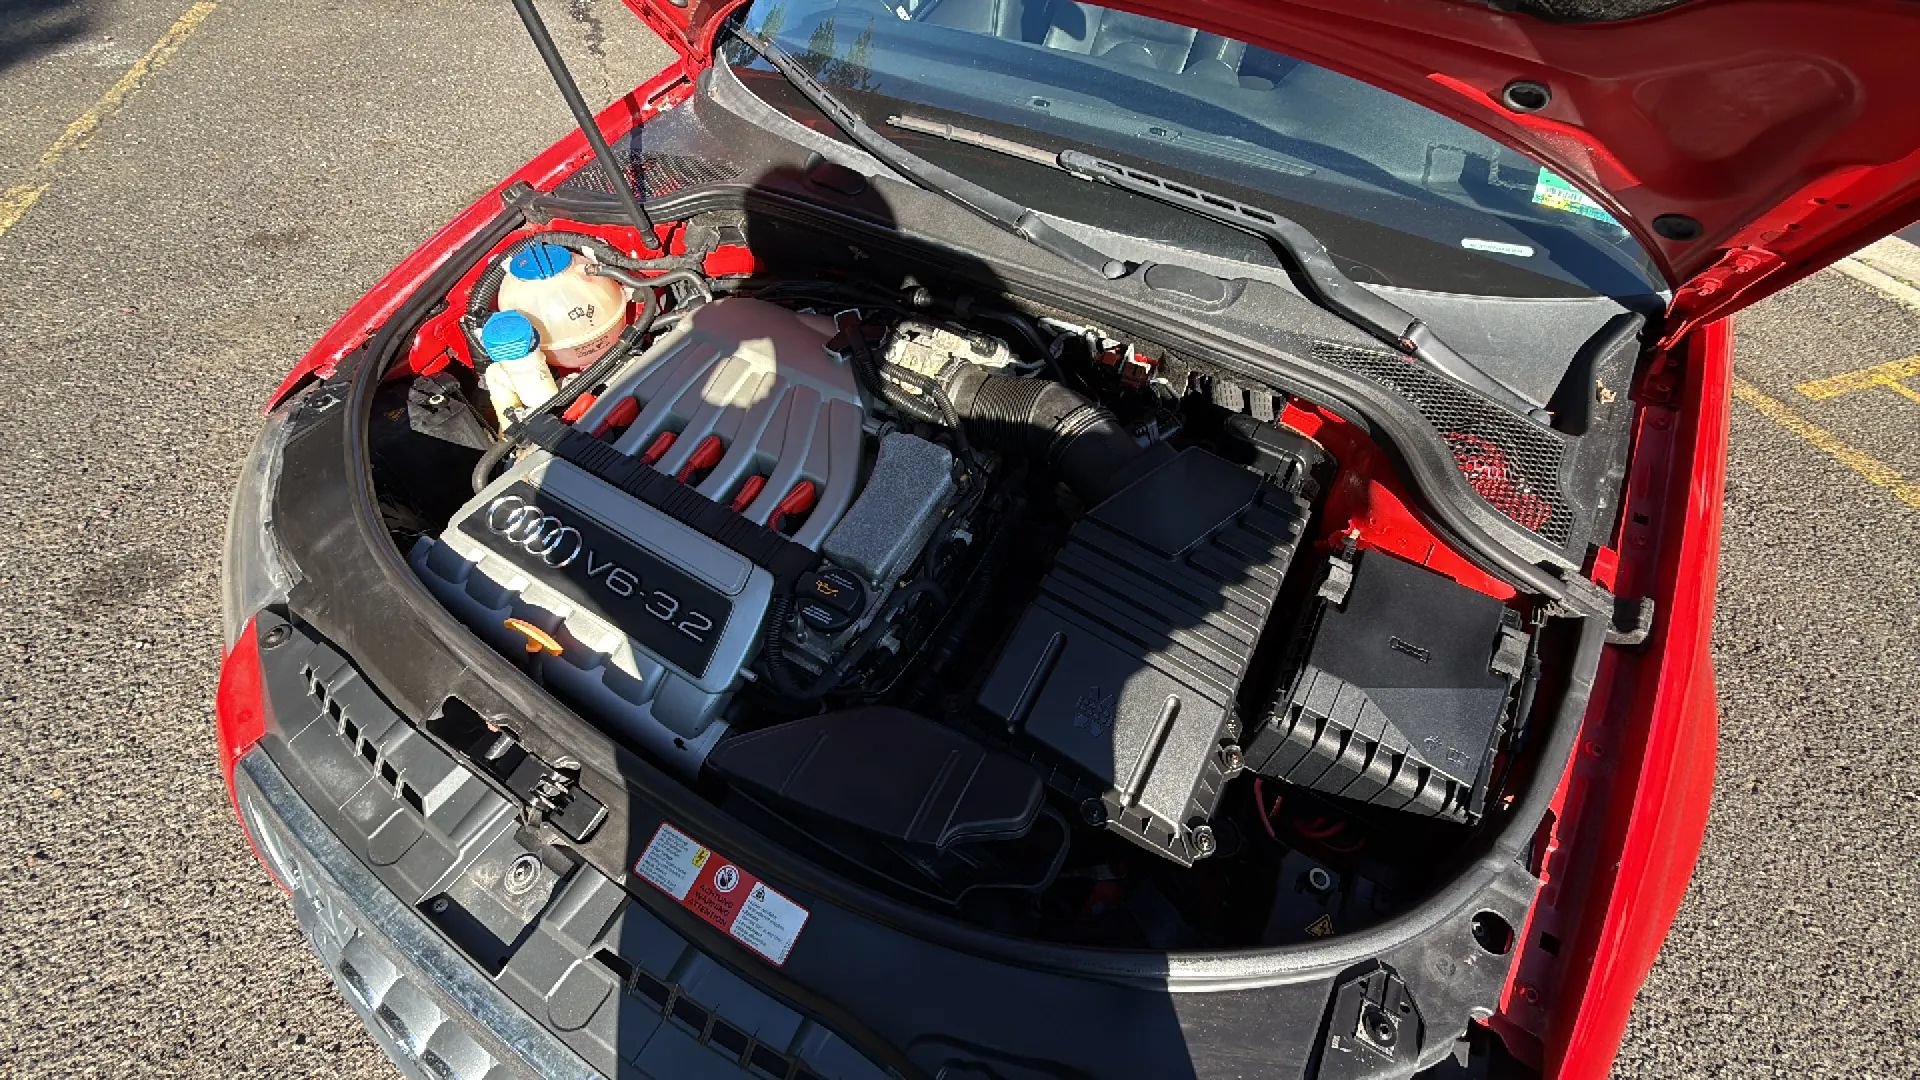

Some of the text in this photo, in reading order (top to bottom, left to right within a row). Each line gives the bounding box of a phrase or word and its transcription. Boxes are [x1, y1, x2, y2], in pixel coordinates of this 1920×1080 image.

[694, 891, 730, 917] WARNING
[699, 884, 734, 909] ACHTUNG
[689, 899, 728, 926] ATTENTION
